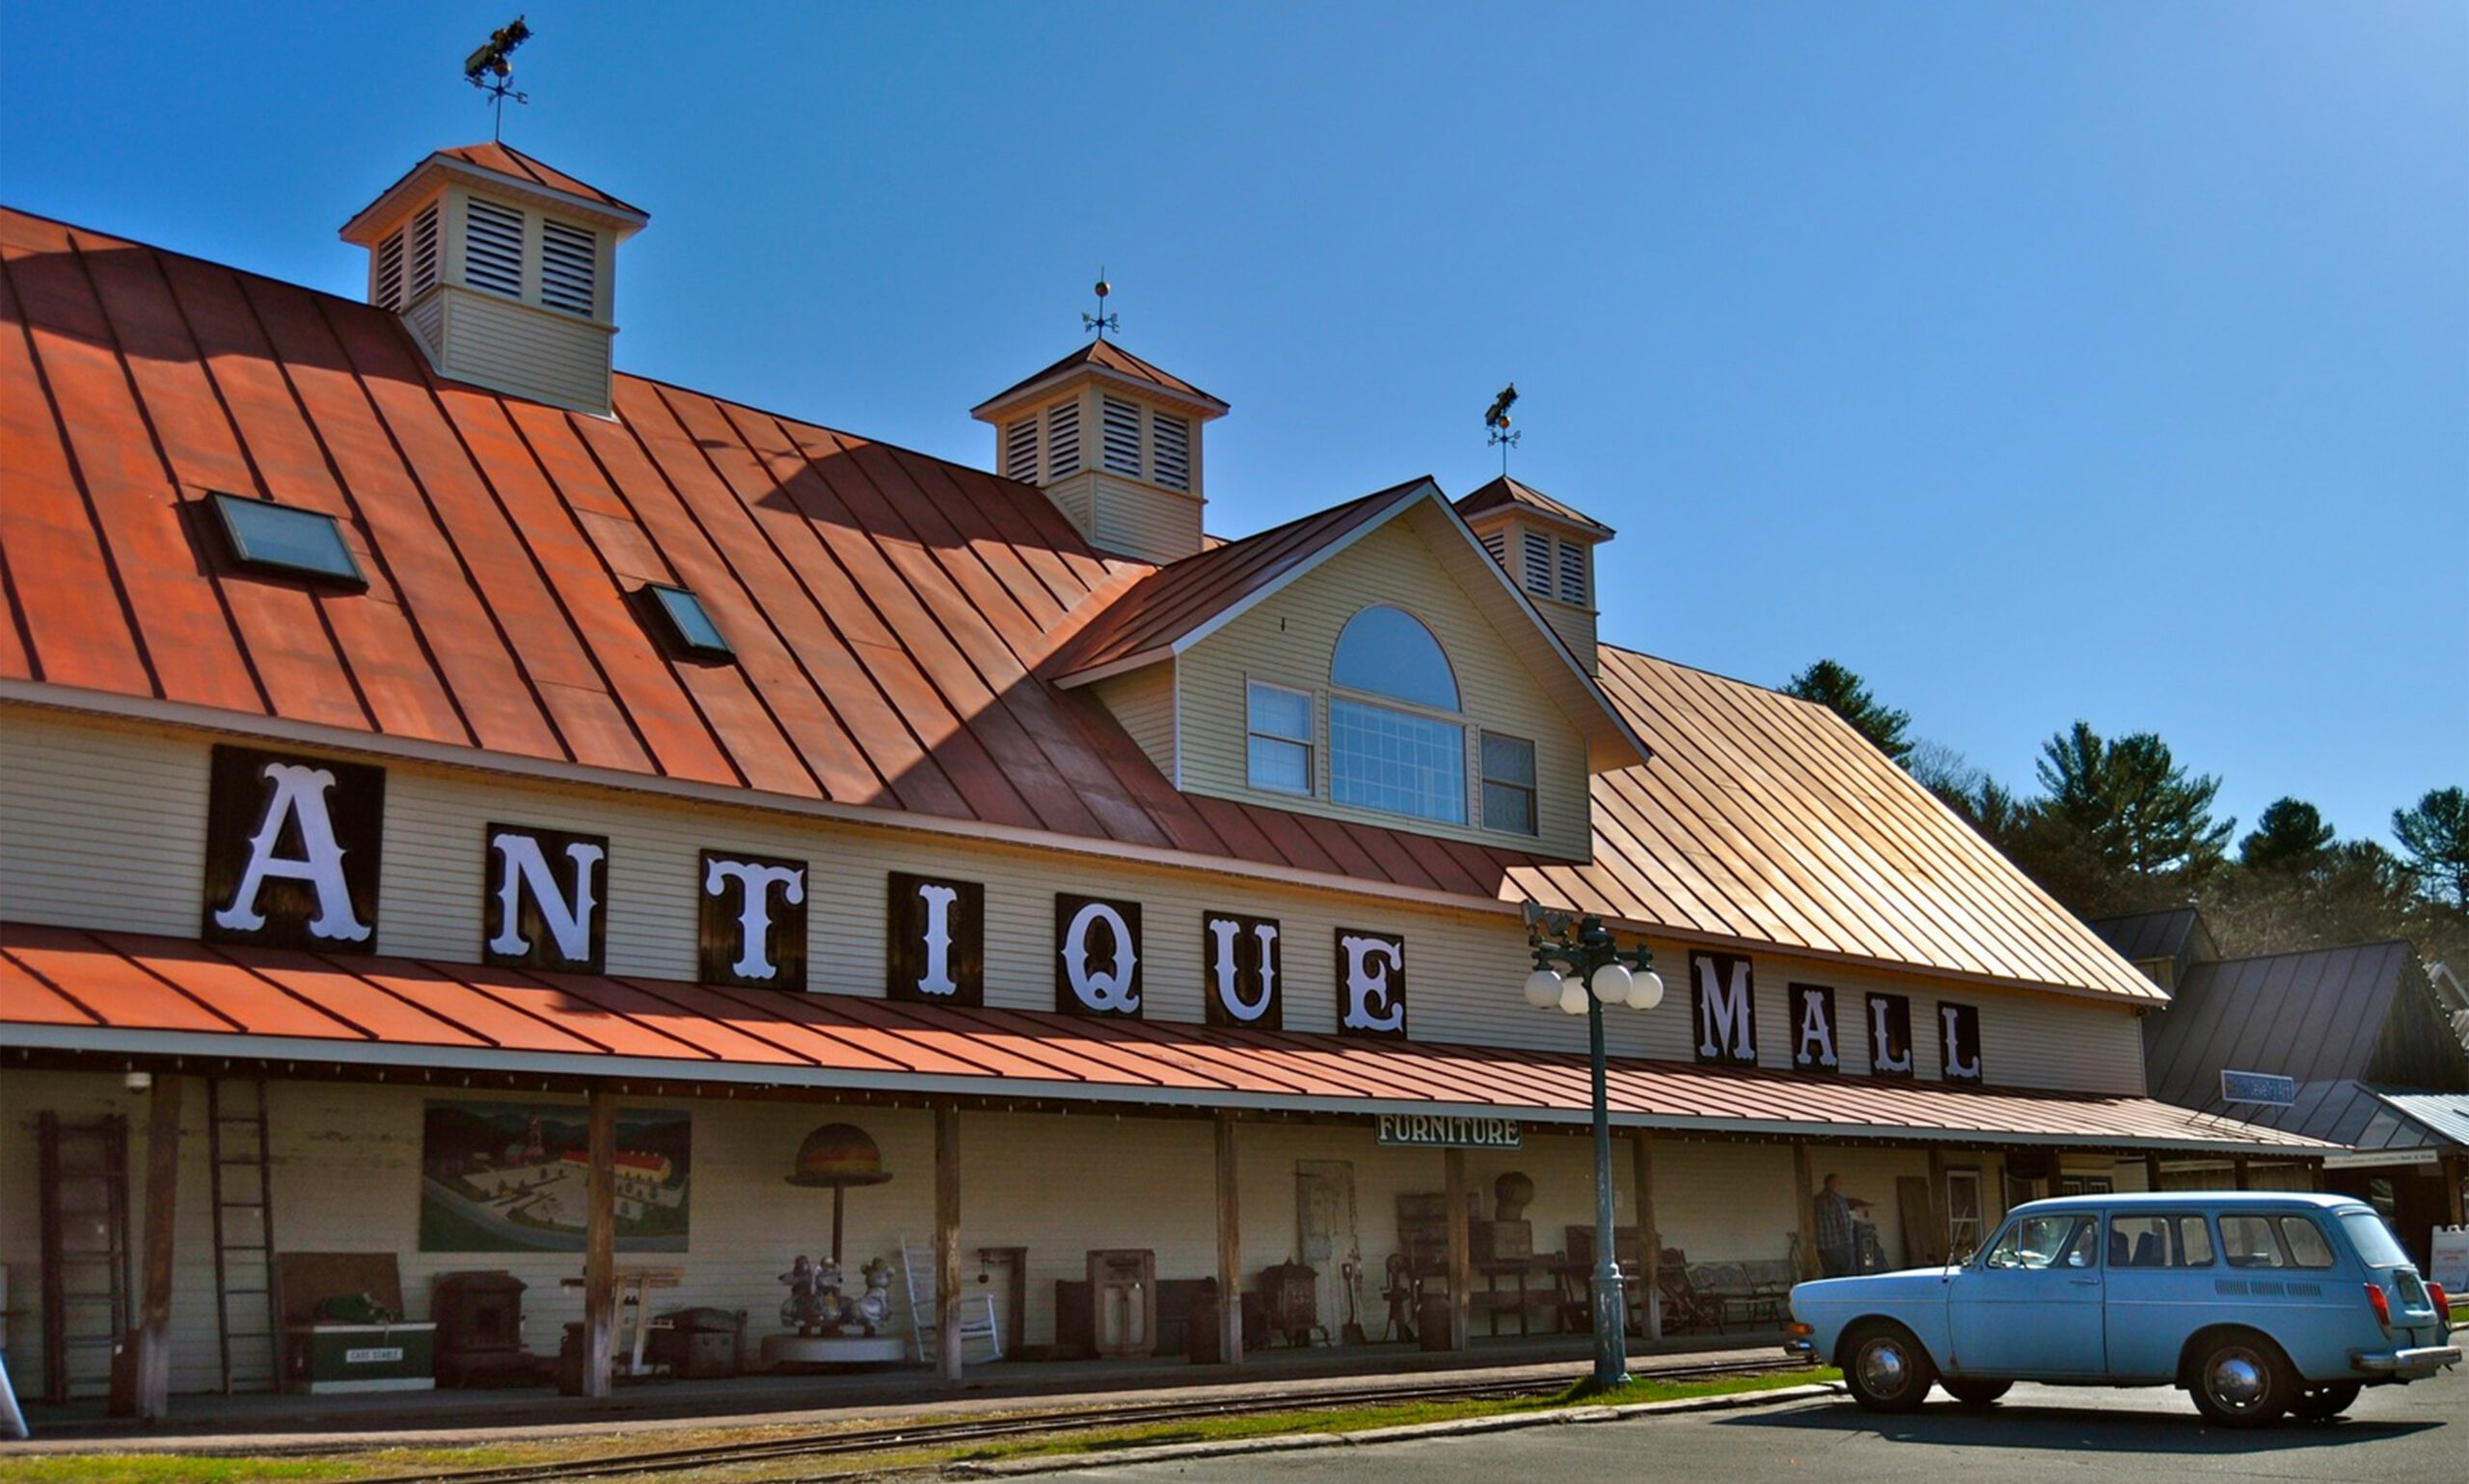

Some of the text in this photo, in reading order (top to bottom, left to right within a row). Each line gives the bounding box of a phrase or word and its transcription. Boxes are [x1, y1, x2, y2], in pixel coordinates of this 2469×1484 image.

[214, 762, 1980, 1078] ANTIQUE MALL
[1378, 1114, 1520, 1146] FURNITURE
